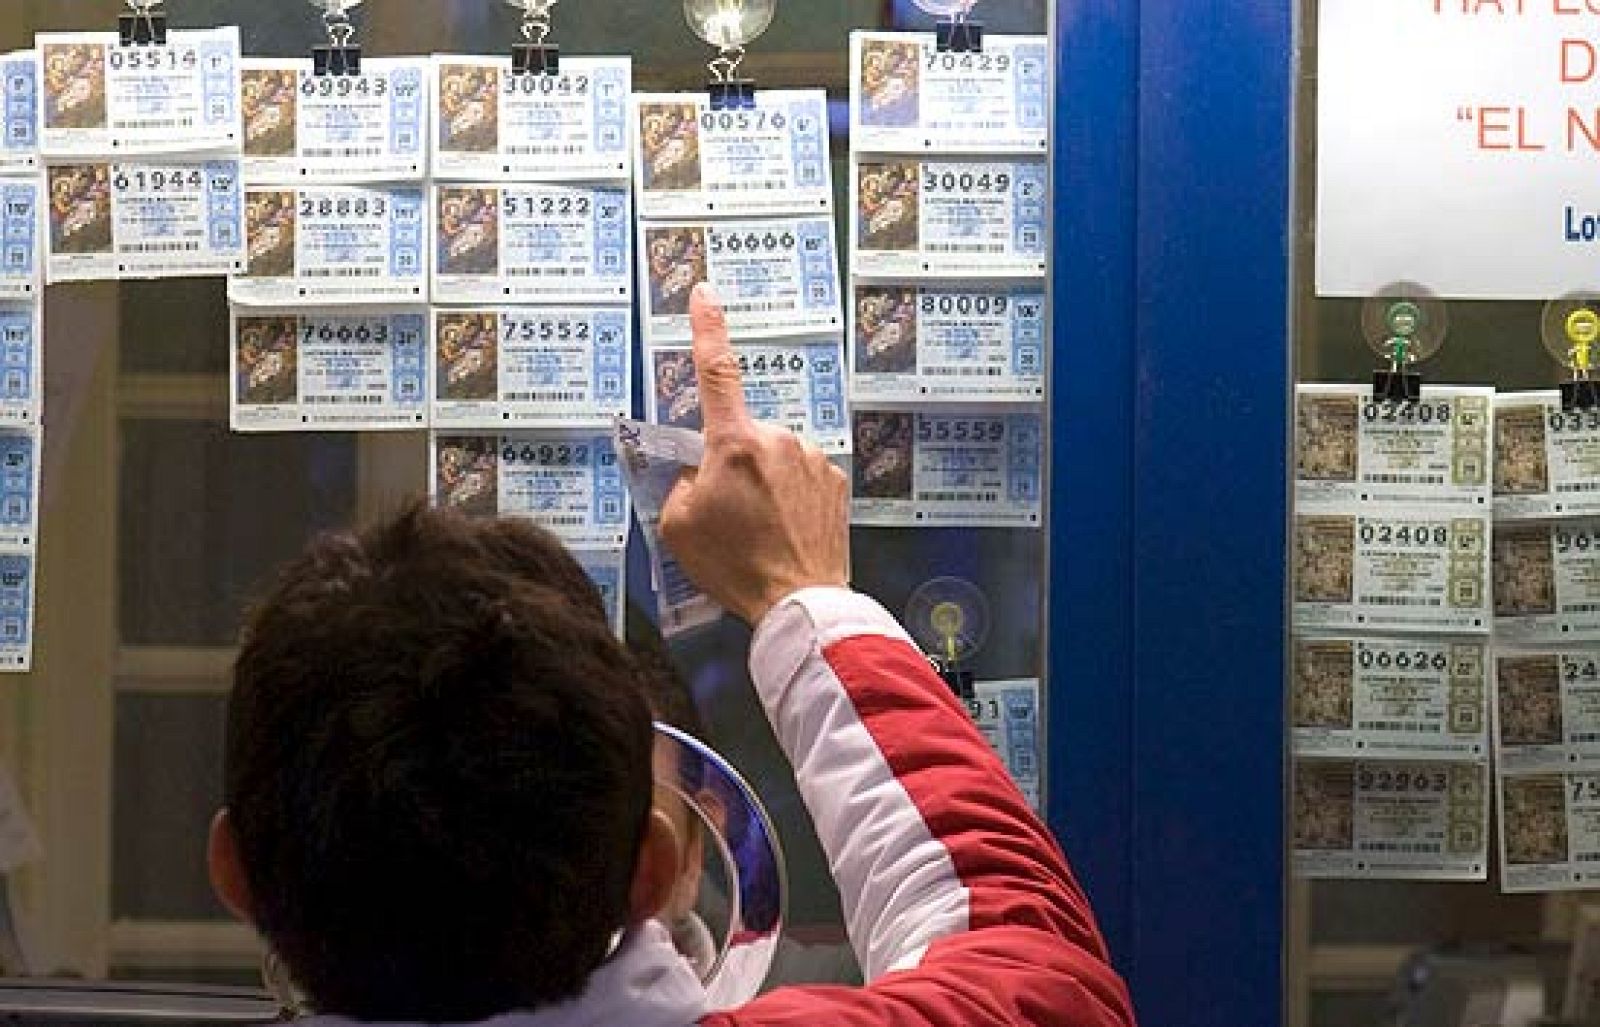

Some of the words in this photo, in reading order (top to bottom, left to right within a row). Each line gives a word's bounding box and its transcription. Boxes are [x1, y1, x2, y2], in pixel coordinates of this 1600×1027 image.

[110, 48, 196, 71] 05514
[924, 54, 1010, 73] 70429
[301, 77, 387, 97] 69943
[504, 75, 590, 96] 30042
[701, 111, 786, 132] 00576
[113, 171, 202, 191] 61944
[924, 173, 1010, 193] 30049
[300, 197, 386, 217] 28883
[504, 197, 591, 216] 51222
[1564, 205, 1600, 242] Lo
[709, 231, 795, 252] 56666
[921, 295, 1007, 315] 80009
[301, 324, 388, 344] 76663
[502, 321, 589, 341] 75552
[1362, 400, 1451, 423] 02408
[918, 420, 1005, 442] 55559
[502, 444, 588, 465] 66922
[1359, 525, 1448, 545] 02408
[1358, 650, 1447, 671] 06626
